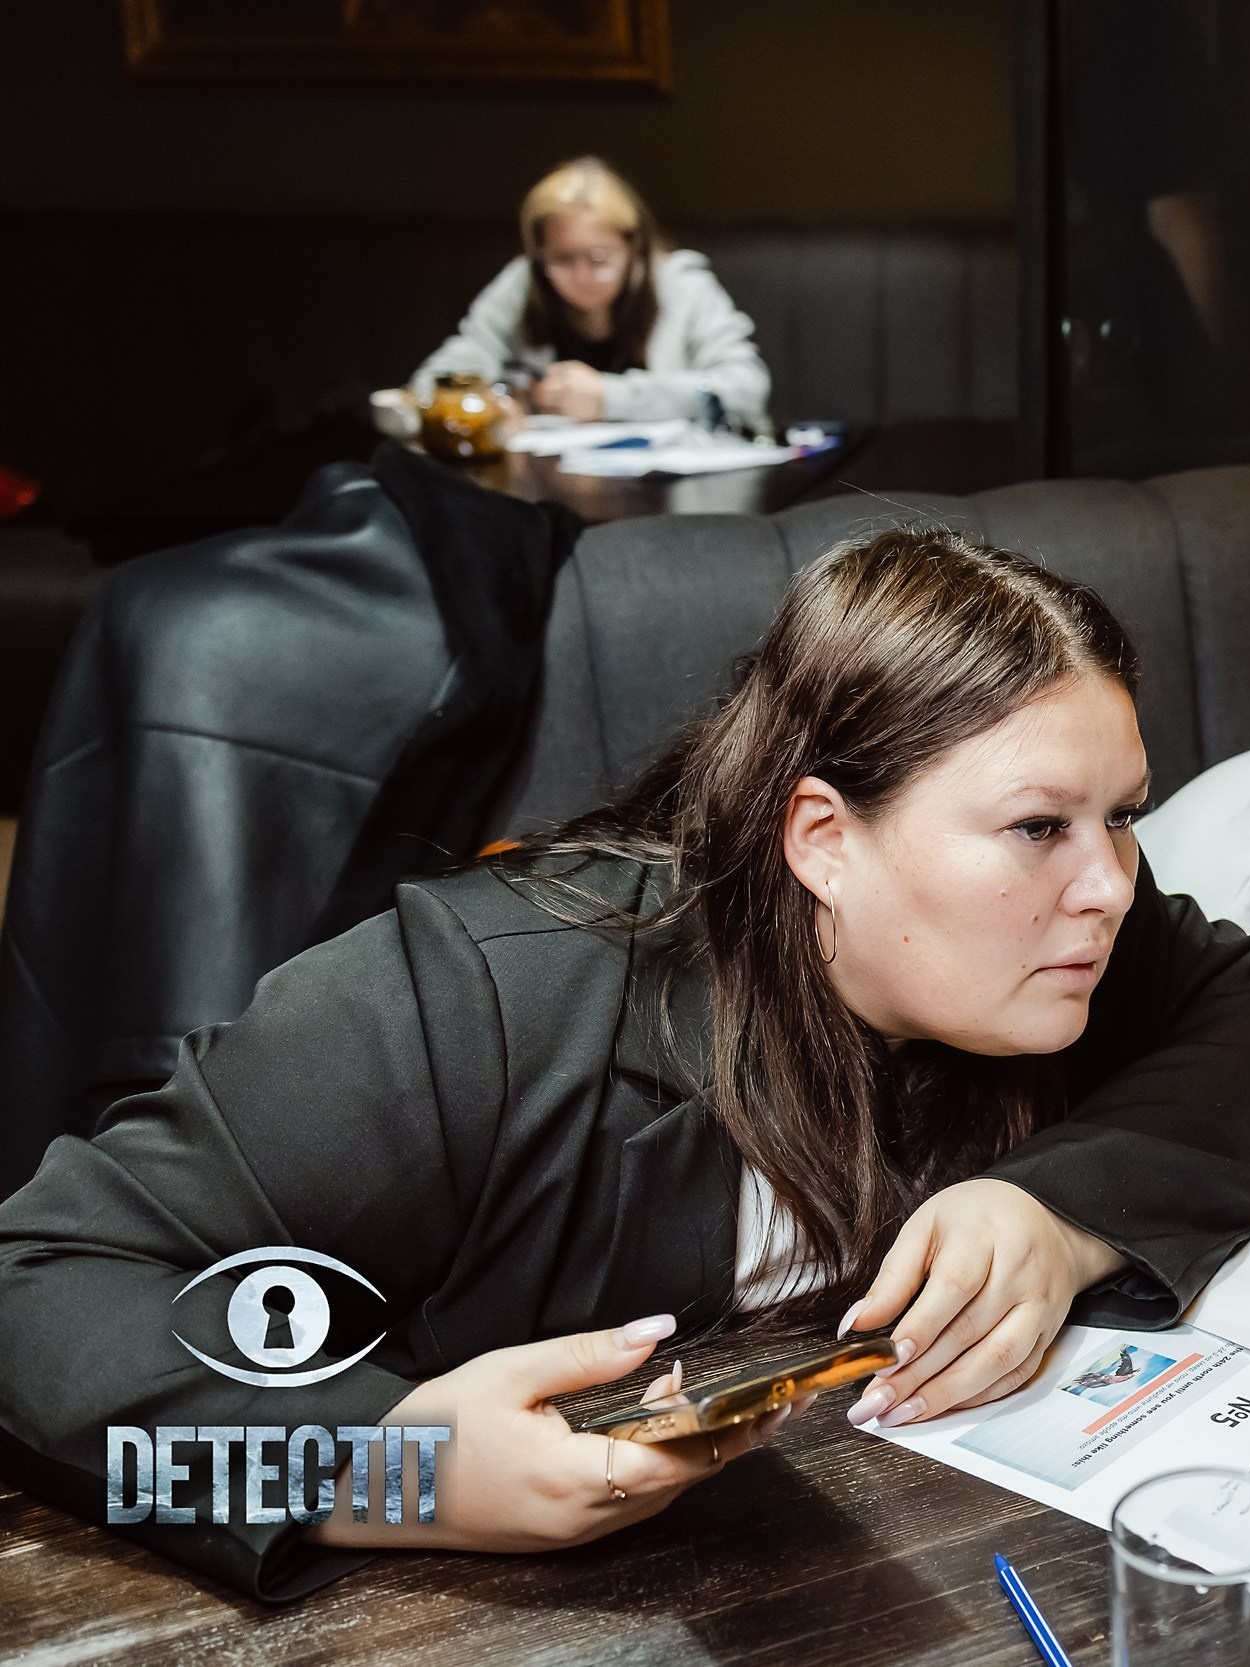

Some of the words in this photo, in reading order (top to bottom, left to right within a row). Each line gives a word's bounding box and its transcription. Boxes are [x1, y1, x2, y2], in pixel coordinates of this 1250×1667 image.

[1227, 1346, 1246, 1357] the
[1210, 1355, 1233, 1368] 24th
[1190, 1367, 1216, 1382] north
[1173, 1381, 1196, 1394] until
[1159, 1393, 1178, 1404] you
[1144, 1403, 1164, 1415] see
[1103, 1413, 1149, 1443] something
[1087, 1441, 1109, 1454] like
[1068, 1452, 1093, 1467] this:
